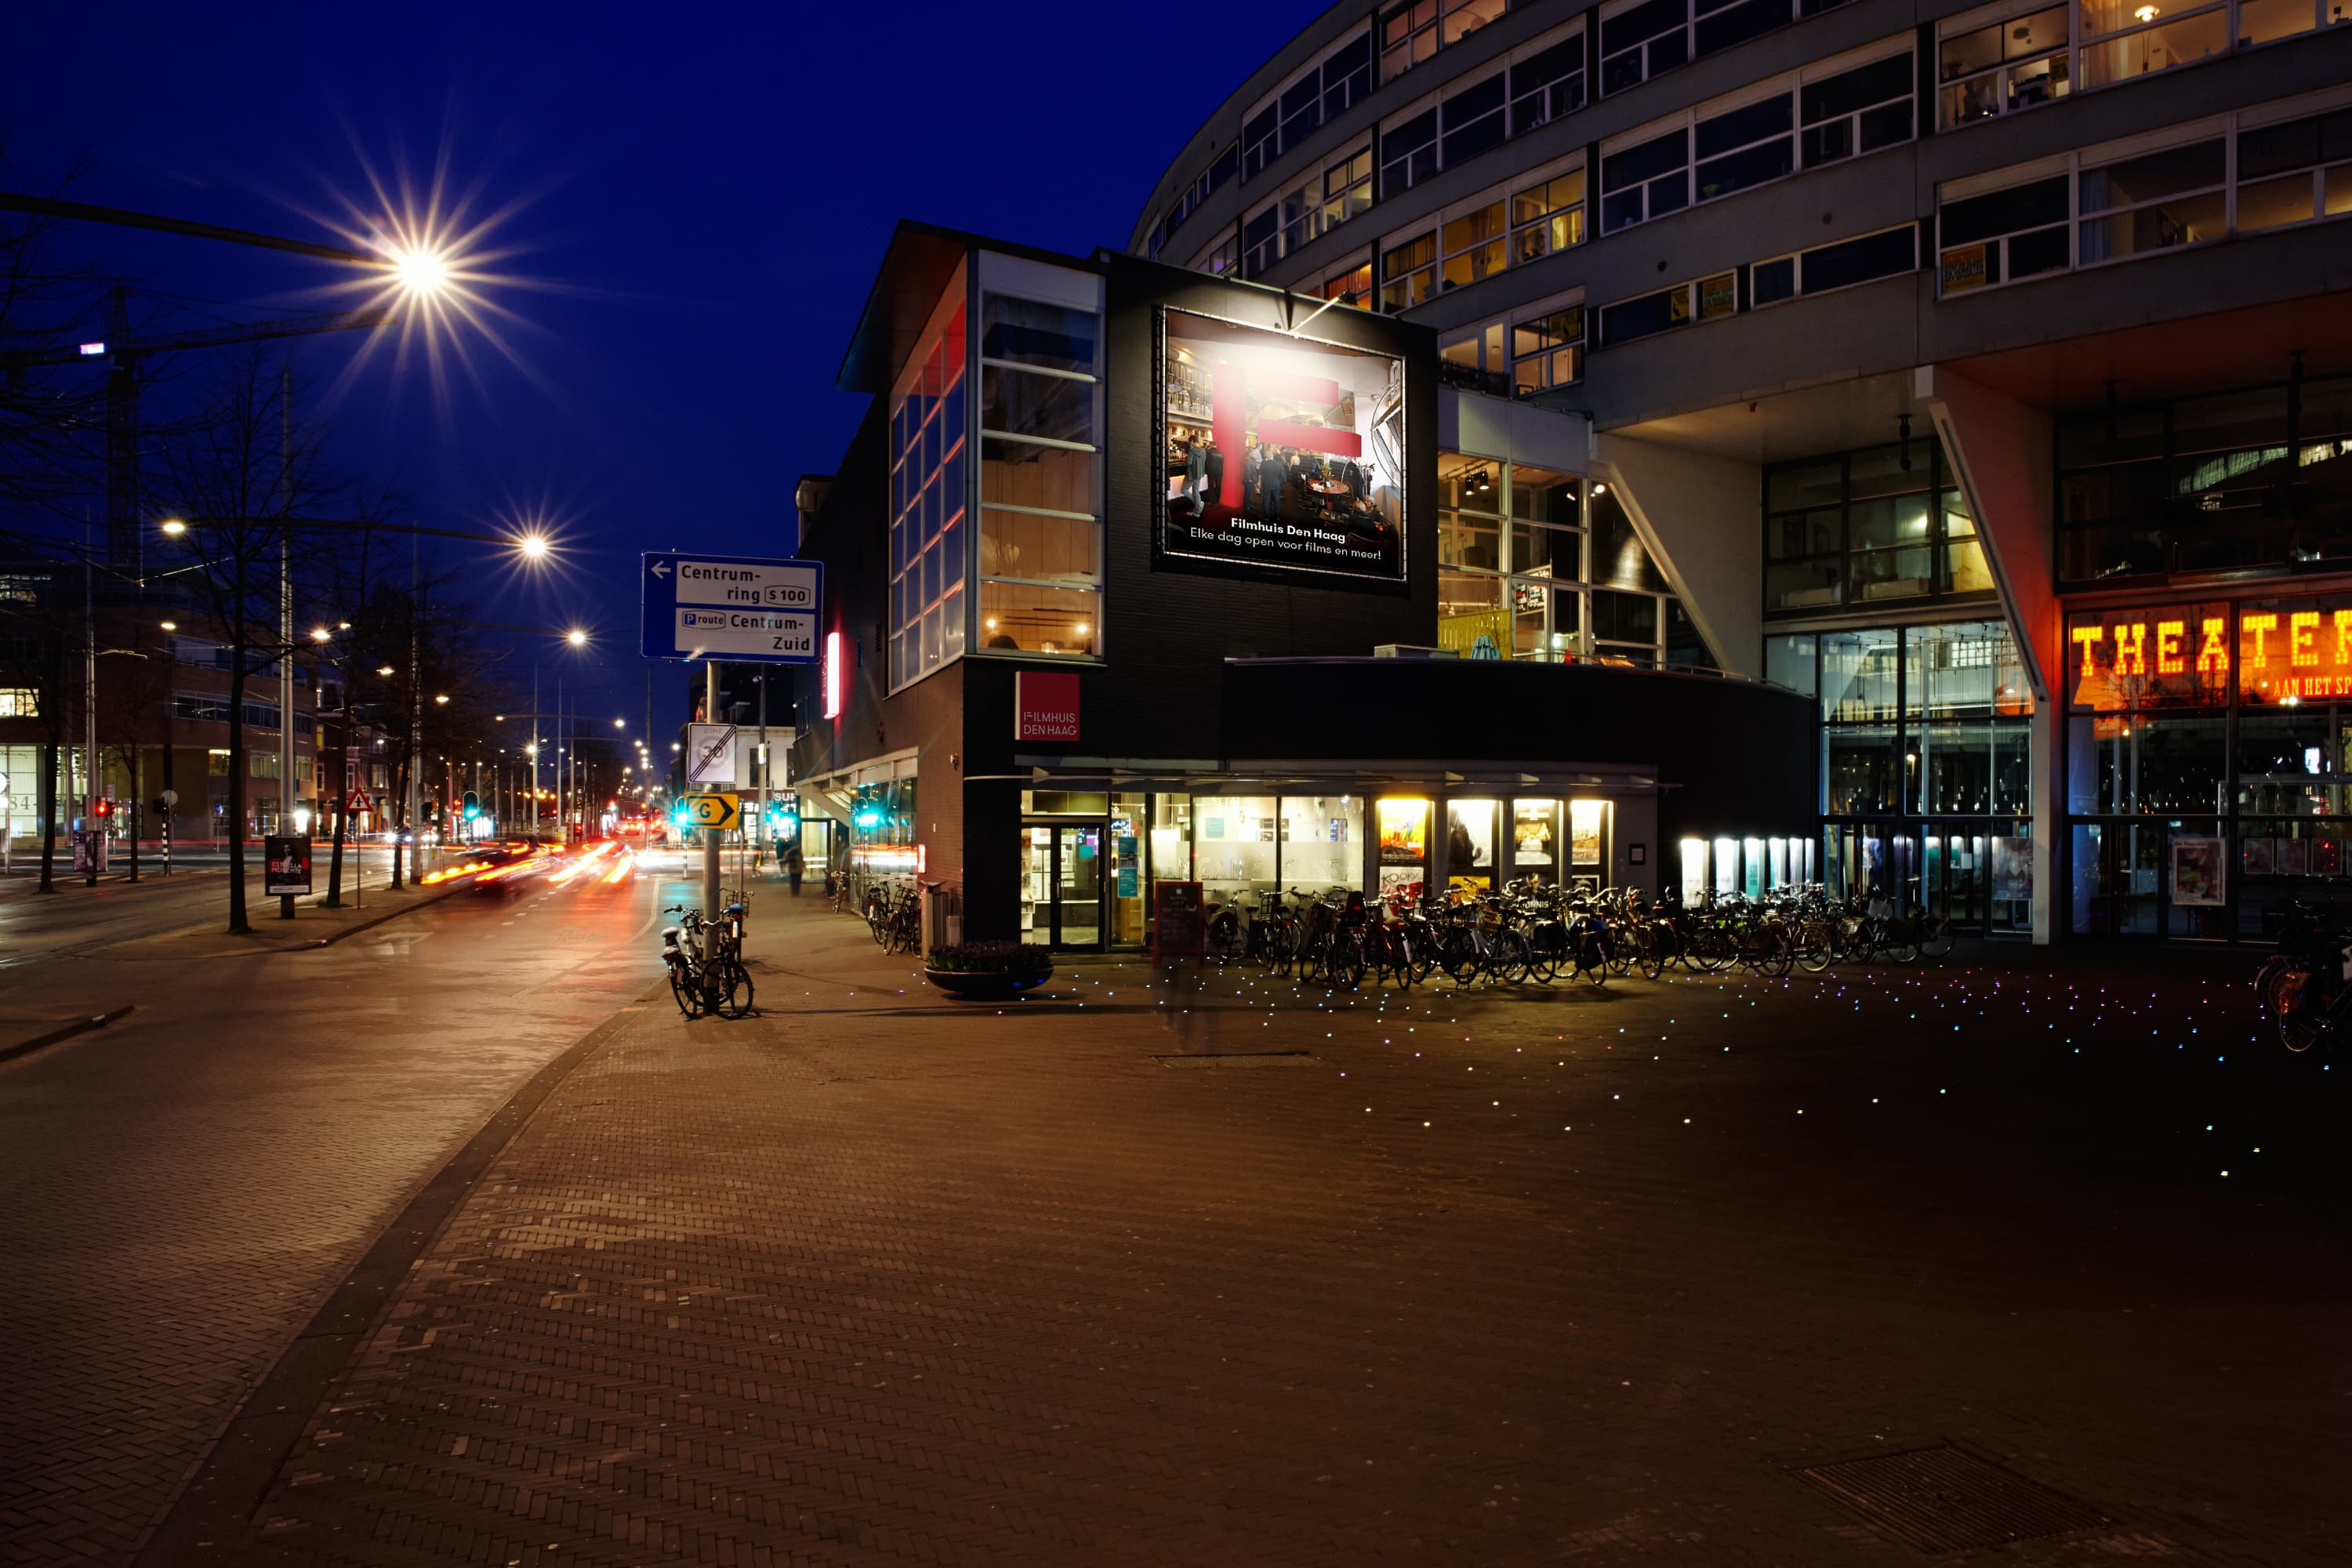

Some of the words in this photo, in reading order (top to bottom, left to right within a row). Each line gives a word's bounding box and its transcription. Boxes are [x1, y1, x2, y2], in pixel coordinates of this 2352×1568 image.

[1231, 517, 1284, 534] Filmhuis
[1287, 524, 1312, 537] Den
[1314, 528, 1345, 544] Haag
[1190, 527, 1214, 539] Elke
[1218, 531, 1241, 546] dag
[1245, 537, 1274, 548] open
[1277, 540, 1303, 550] voor
[1305, 542, 1332, 554] films
[1335, 548, 1348, 557] en
[1351, 550, 1381, 561] meer!
[681, 565, 760, 582] Centrum-
[727, 586, 760, 604] ring
[769, 590, 776, 601] S
[780, 590, 806, 602] 100
[698, 615, 724, 625] route
[731, 614, 804, 630] Centrum-
[773, 636, 809, 652] Zuid
[2273, 677, 2299, 697] AAN
[2304, 677, 2332, 695] HET
[1023, 711, 1076, 722] FILMHUIS
[1023, 724, 1045, 735] DEN
[1047, 724, 1077, 736] HAAG
[700, 802, 711, 818] G
